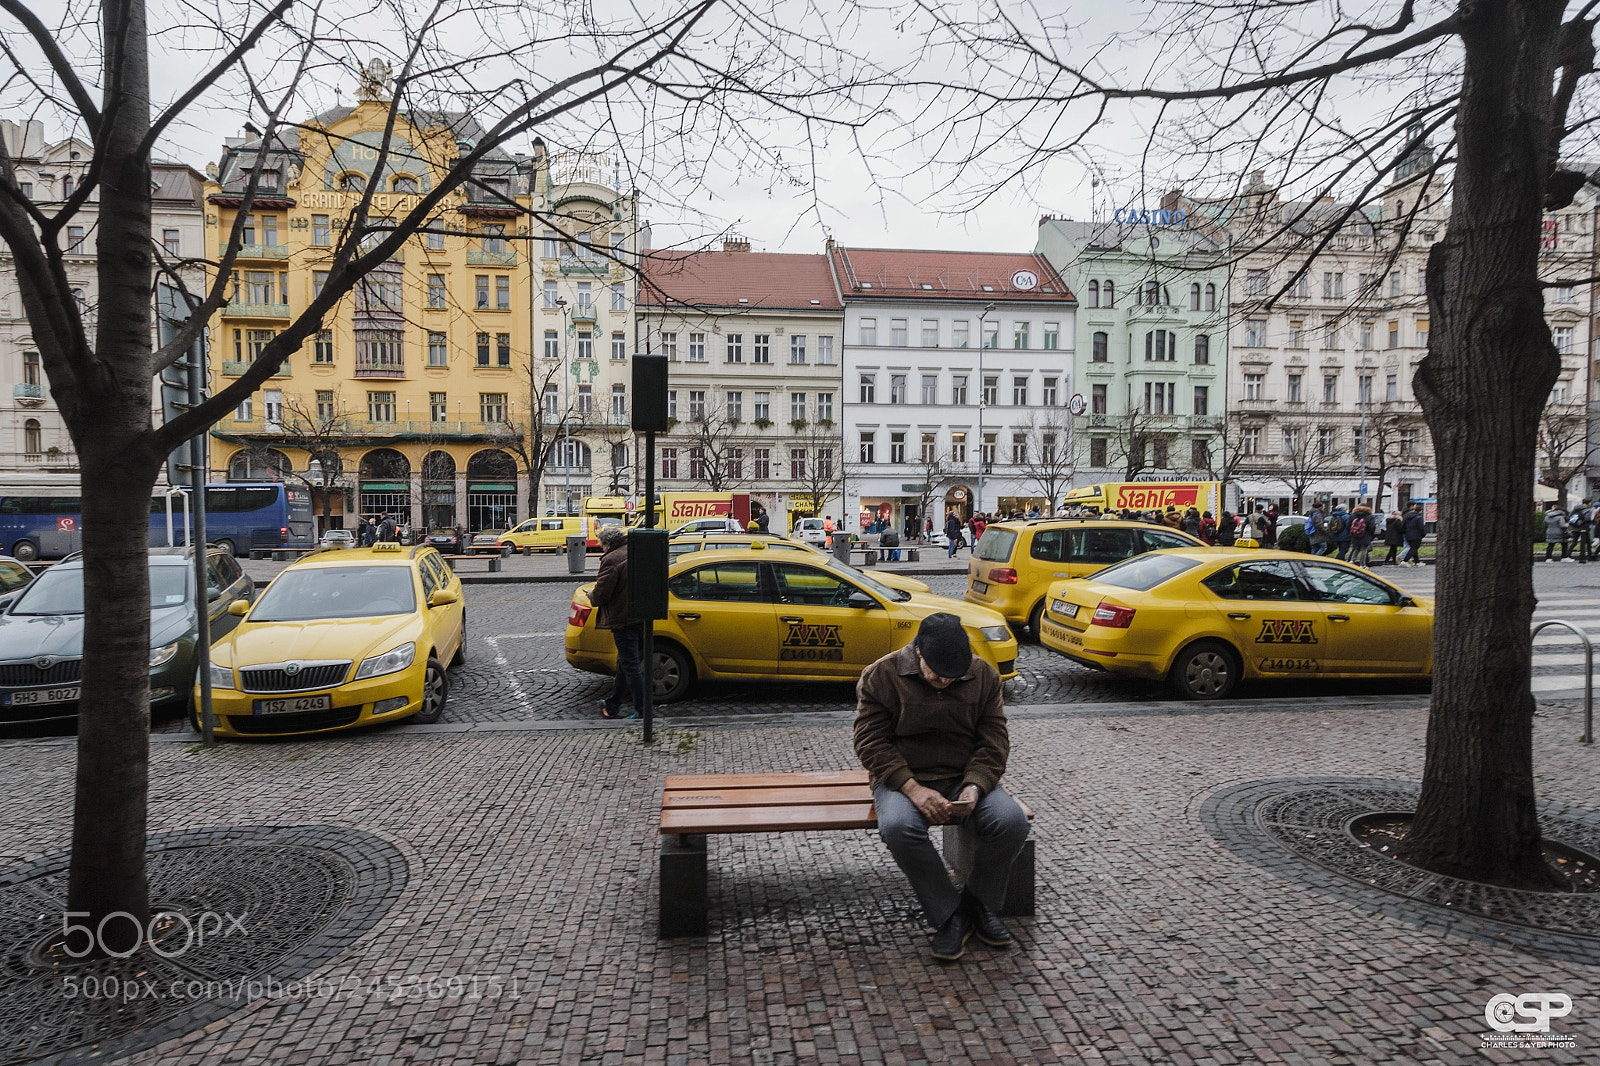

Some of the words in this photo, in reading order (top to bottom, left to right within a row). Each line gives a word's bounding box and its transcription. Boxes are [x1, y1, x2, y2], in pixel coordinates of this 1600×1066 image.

[1114, 208, 1187, 226] CASINO
[1016, 275, 1033, 286] C&A
[1117, 485, 1165, 509] Stahl
[672, 501, 708, 517] Stahl
[783, 624, 844, 647] AAA
[1255, 620, 1318, 644] AAA
[14, 692, 38, 704] 5H3
[48, 688, 80, 701] 6027
[265, 700, 286, 713] 1SZ
[295, 697, 325, 711] 4249
